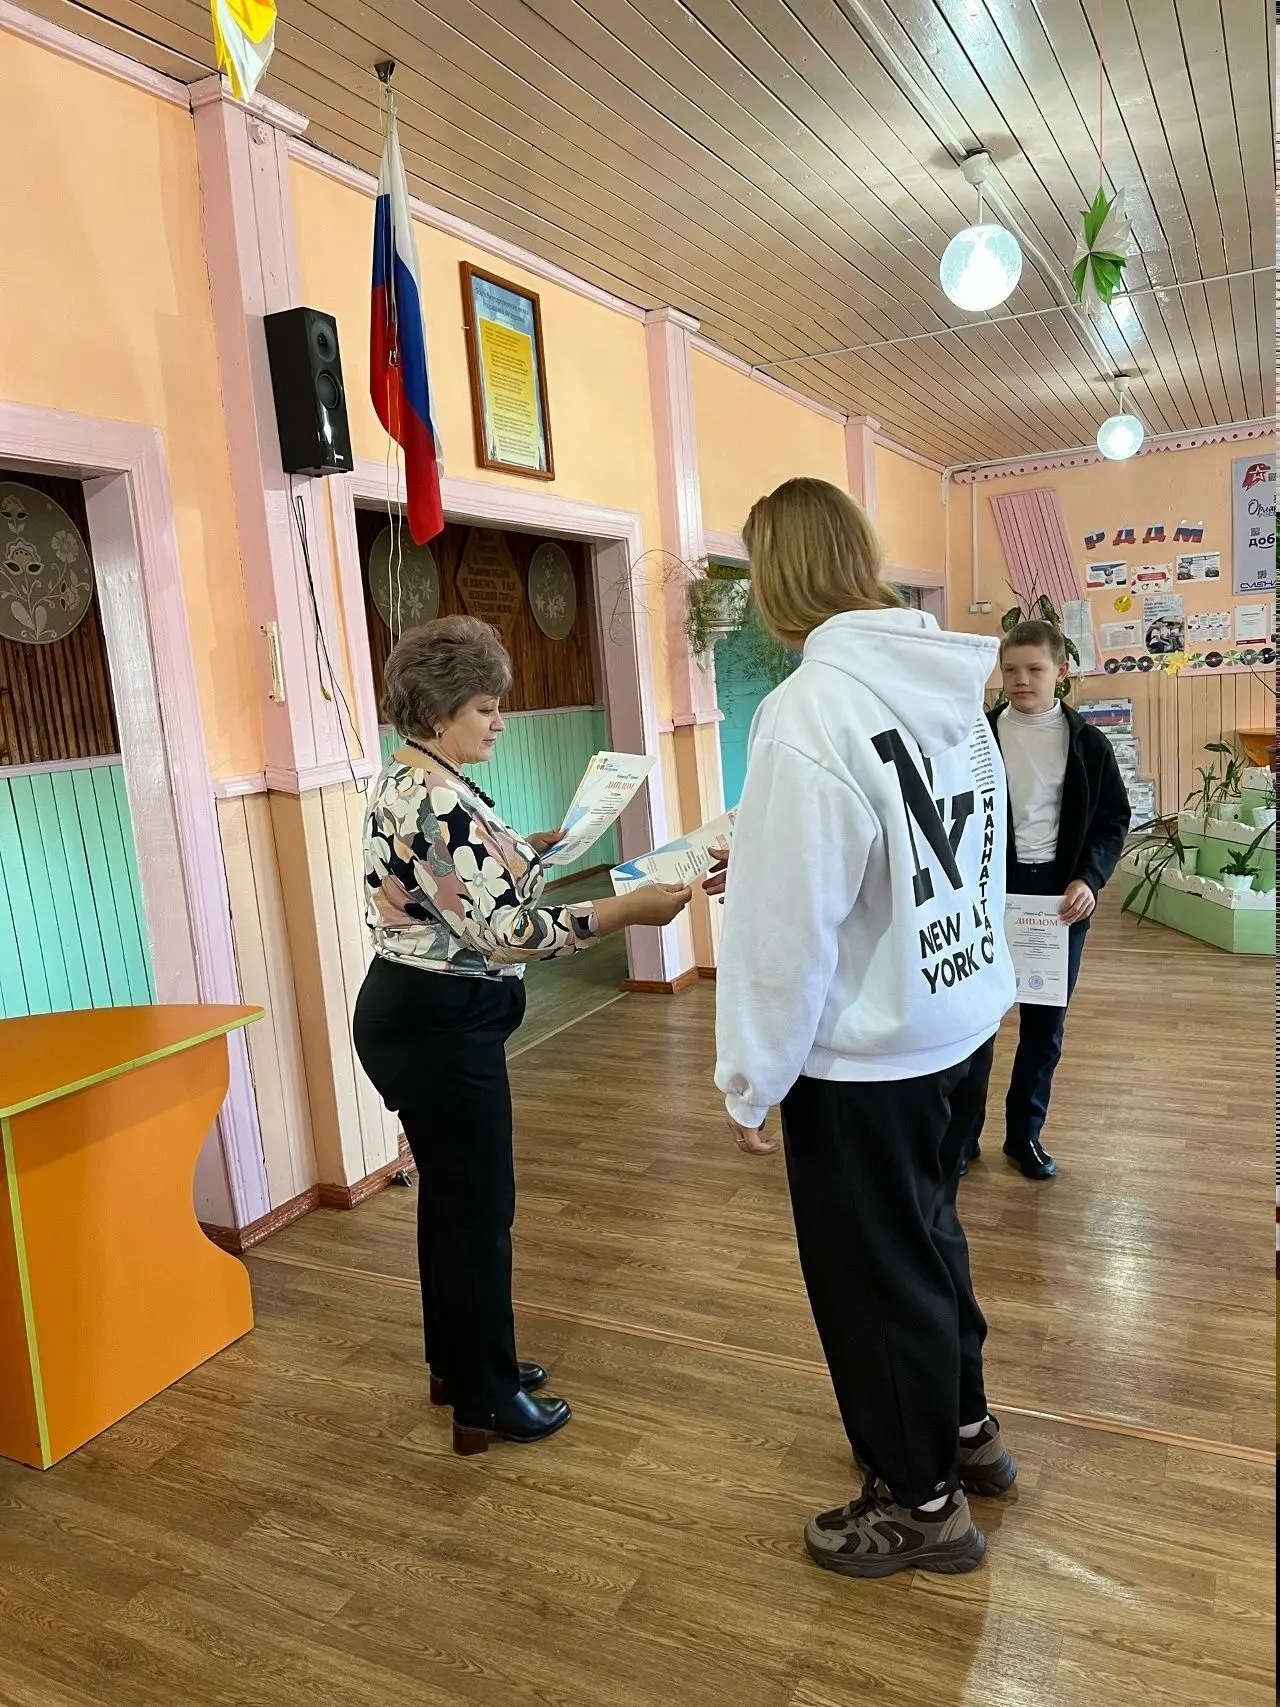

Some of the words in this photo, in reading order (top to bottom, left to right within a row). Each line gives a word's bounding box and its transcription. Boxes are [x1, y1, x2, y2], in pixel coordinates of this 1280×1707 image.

[1084, 520, 1204, 550] РДДМ
[919, 912, 961, 959] NEW
[1015, 917, 1058, 926] ДИПЛОМ
[921, 943, 980, 995] YORK
